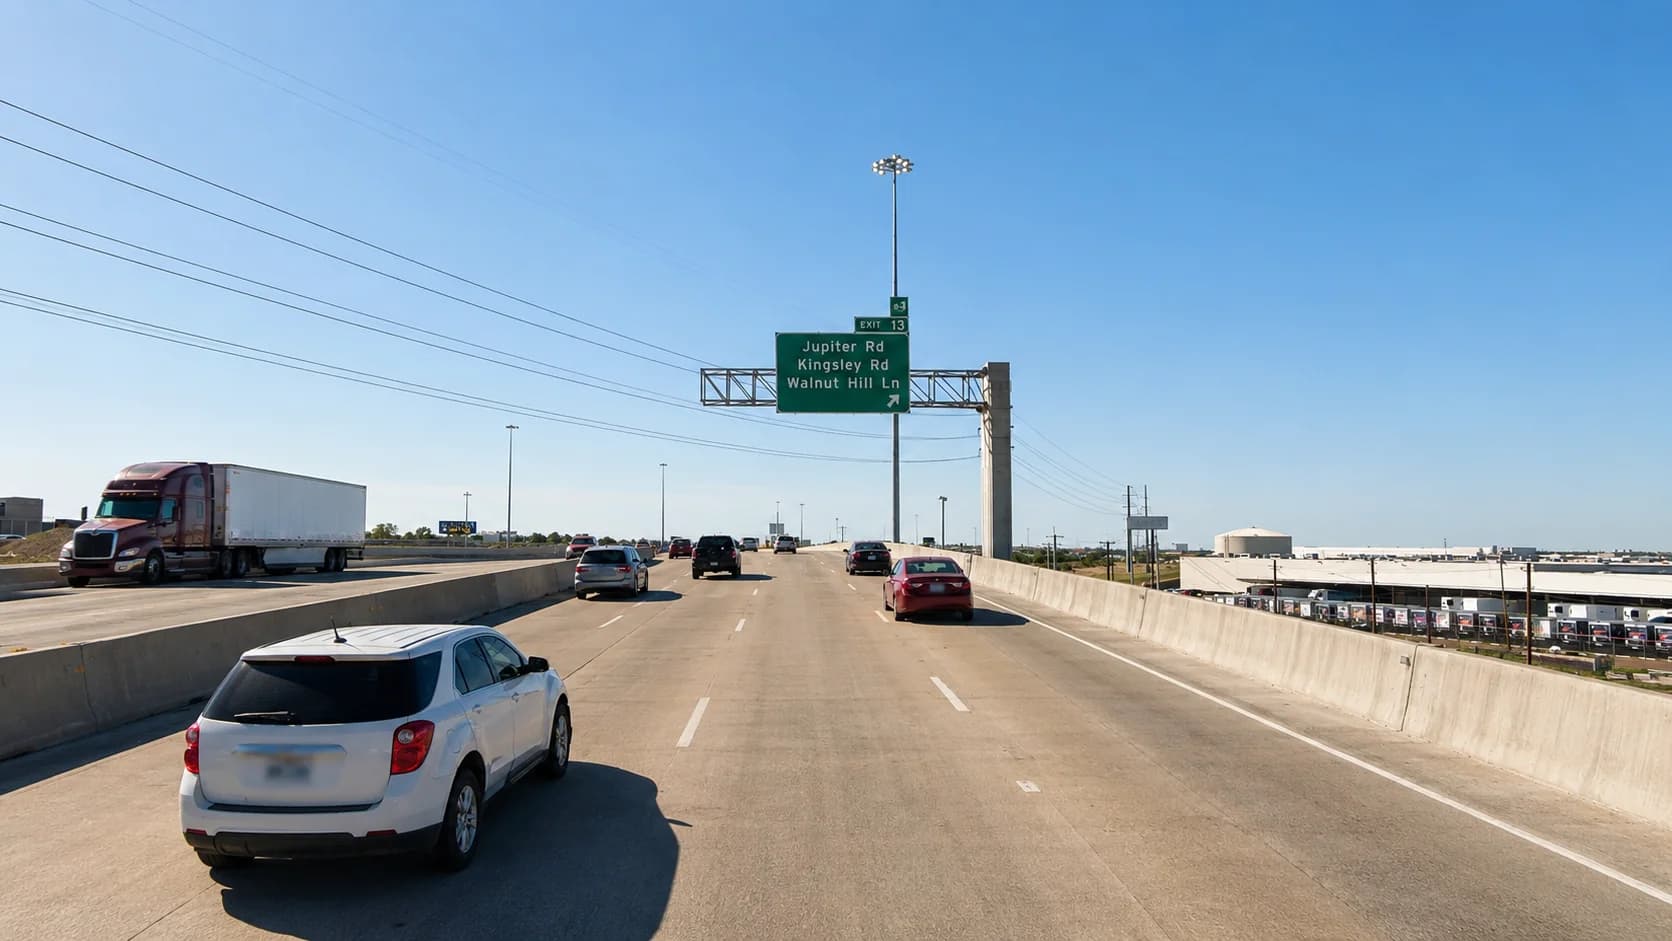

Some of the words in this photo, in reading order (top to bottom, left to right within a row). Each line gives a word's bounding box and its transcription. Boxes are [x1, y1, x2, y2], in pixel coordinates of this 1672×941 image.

[860, 320, 880, 329] EXIT
[891, 319, 905, 331] 13
[802, 340, 857, 355] Jupiter
[865, 340, 884, 353] Rd
[798, 358, 862, 374] Kingsley
[870, 358, 889, 371] Rd
[787, 376, 839, 389] Walnut
[848, 376, 873, 389] Hill
[882, 376, 900, 389] Ln
